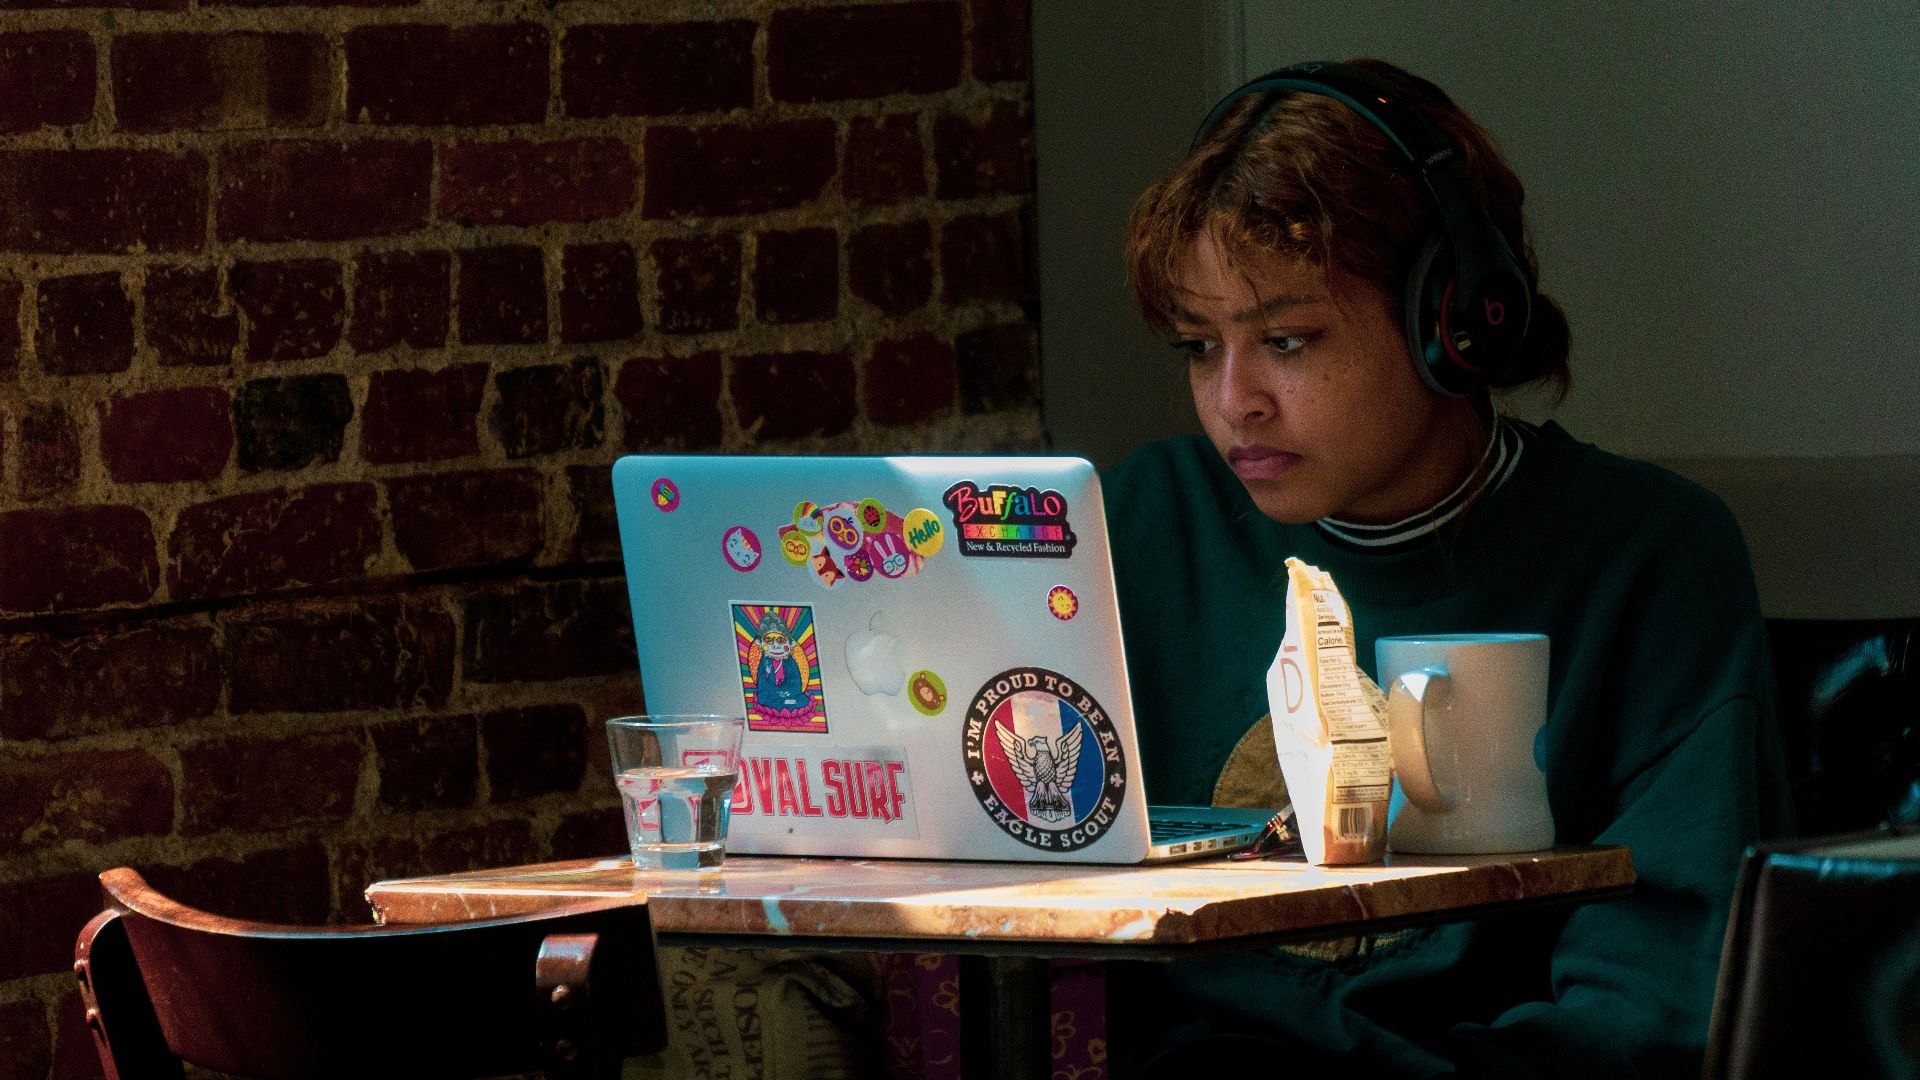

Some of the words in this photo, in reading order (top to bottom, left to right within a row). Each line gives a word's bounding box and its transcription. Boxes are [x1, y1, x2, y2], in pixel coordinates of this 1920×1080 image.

[908, 519, 940, 549] Hello
[966, 541, 985, 551] New
[986, 542, 995, 552] &
[996, 542, 1032, 554] Recycled
[1033, 543, 1065, 553] Fashion
[968, 718, 982, 759] I'M
[975, 672, 1038, 716] PROUD
[1045, 675, 1073, 698] TO
[1077, 696, 1104, 726] BE
[1100, 731, 1120, 763] AN
[821, 759, 905, 824] SURF
[984, 794, 1052, 847] EAGLE
[1060, 796, 1116, 848] SCOUT
